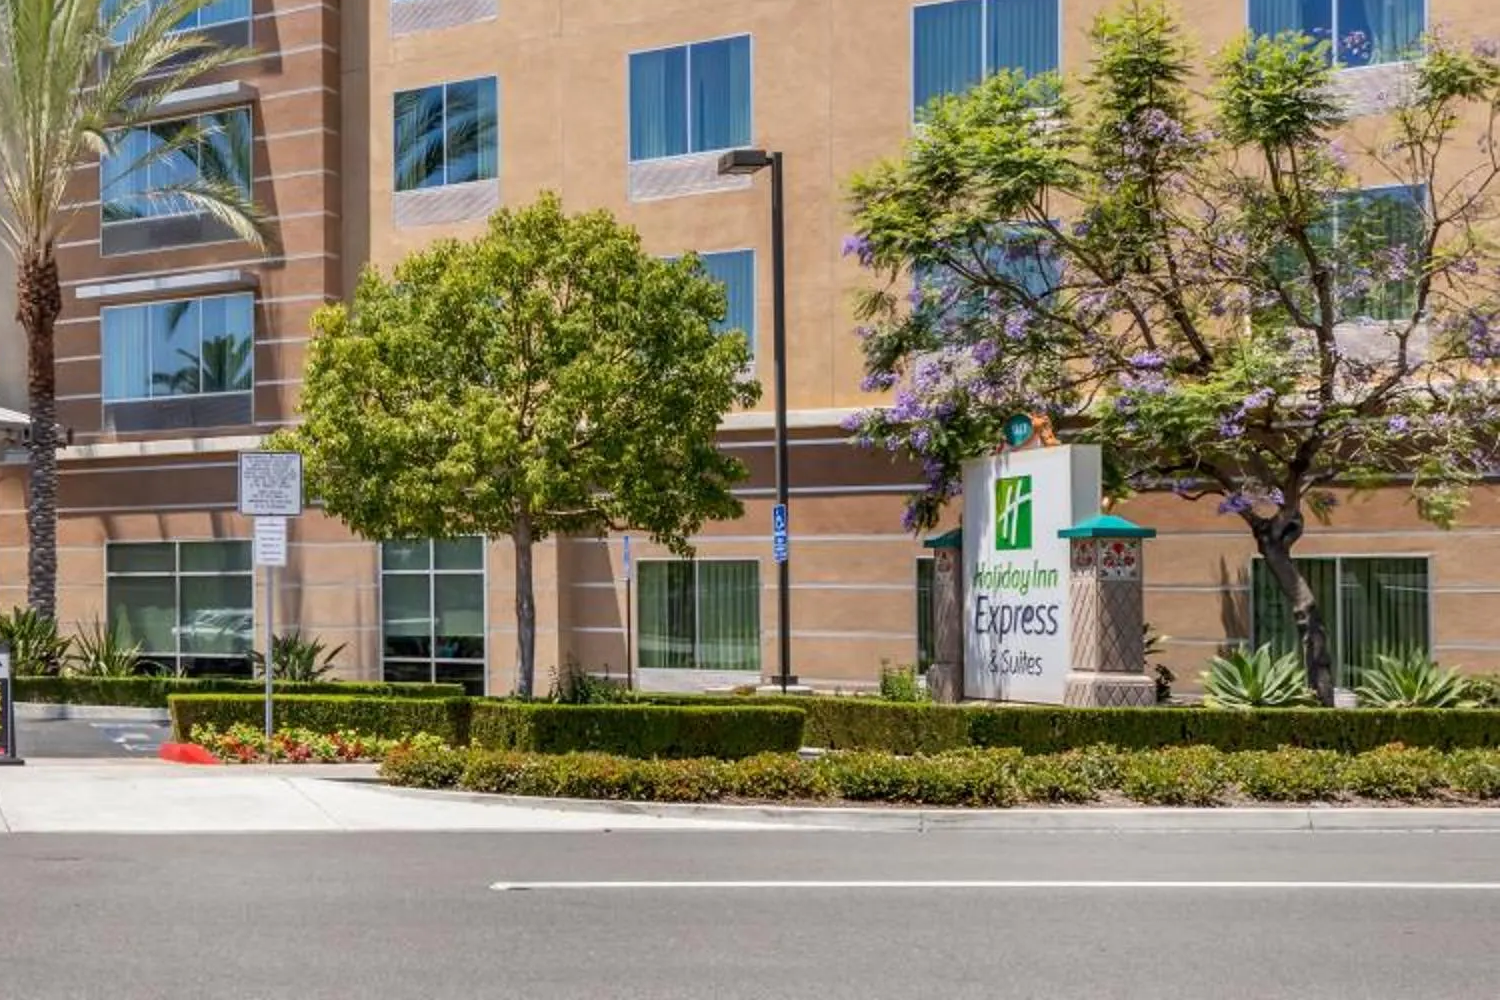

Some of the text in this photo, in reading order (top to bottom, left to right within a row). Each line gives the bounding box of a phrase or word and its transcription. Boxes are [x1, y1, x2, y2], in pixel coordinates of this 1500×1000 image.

[973, 559, 1059, 595] Holiday Inn
[975, 595, 1059, 644] Express
[988, 649, 1043, 676] & Suites
